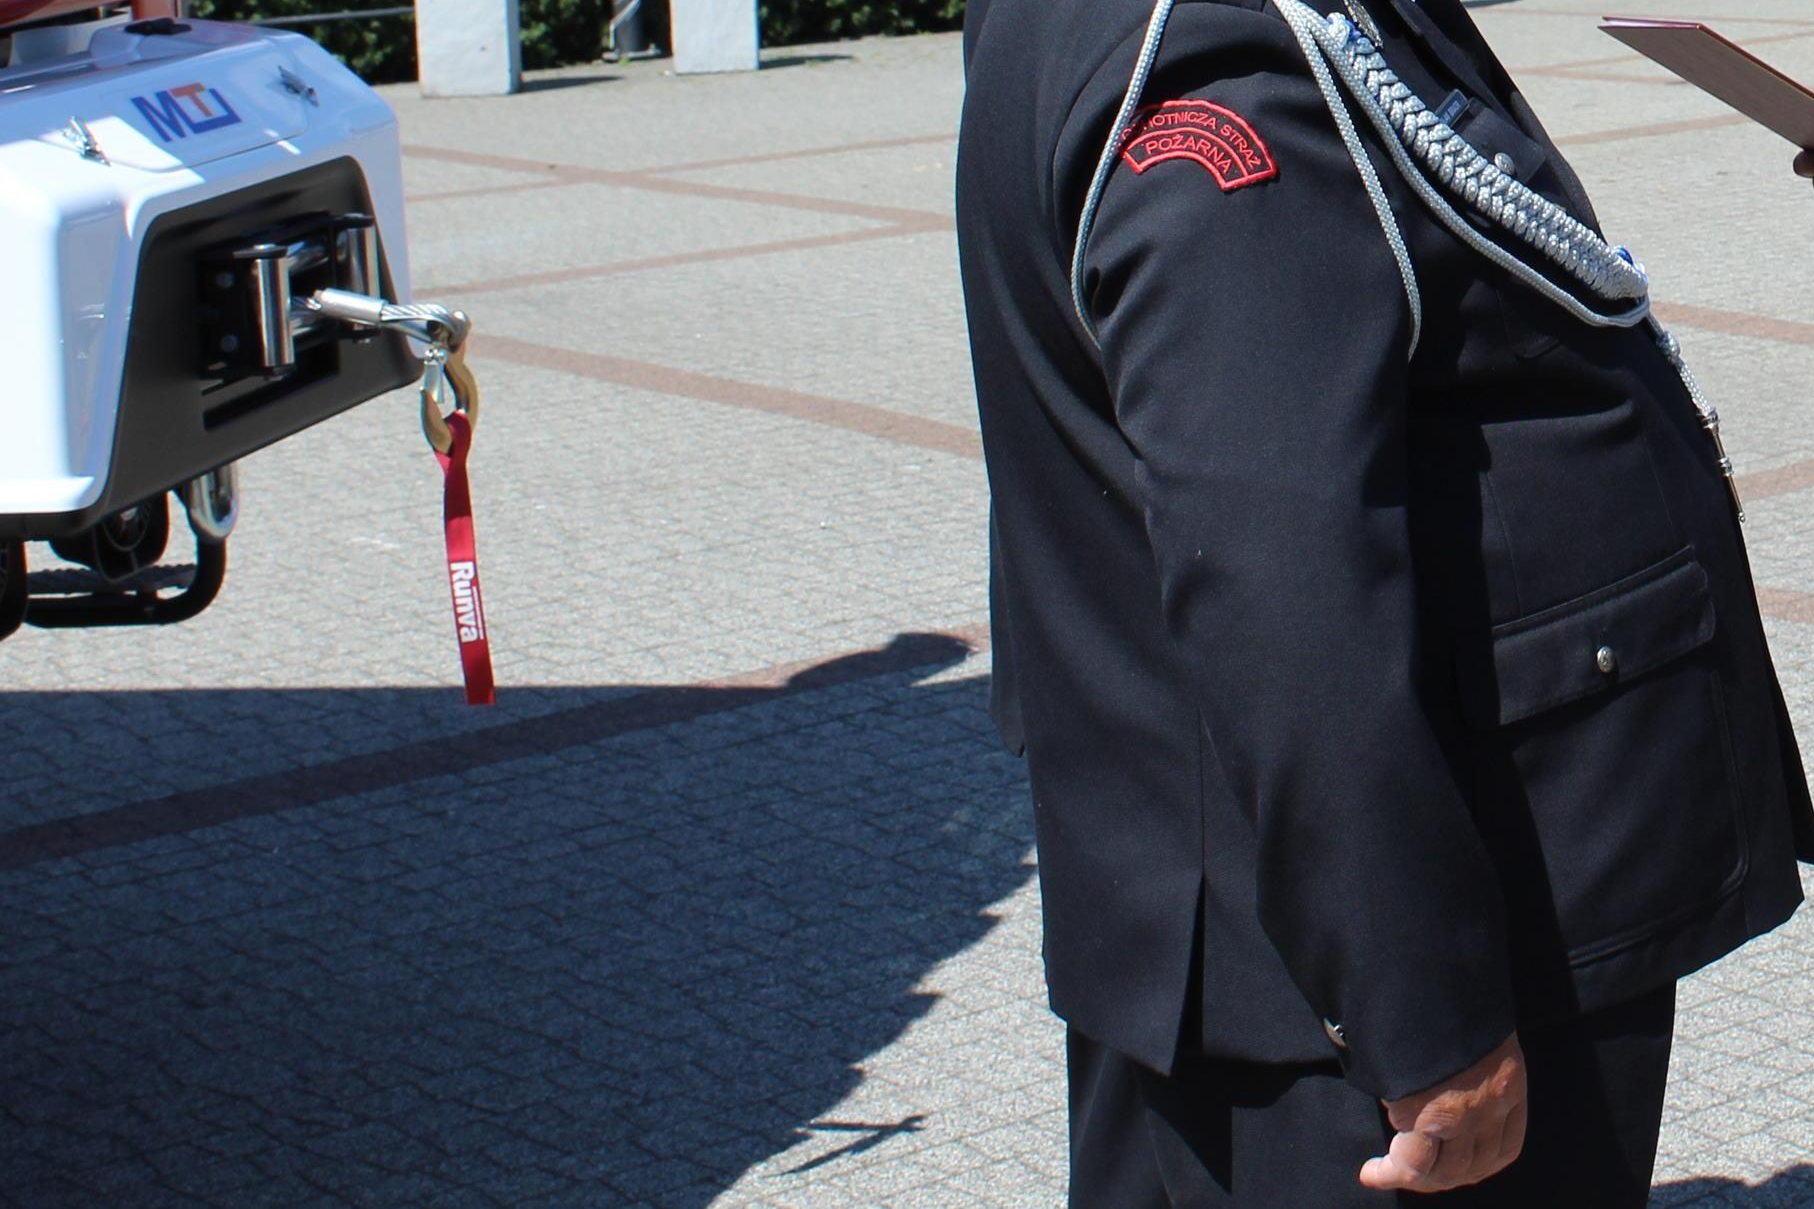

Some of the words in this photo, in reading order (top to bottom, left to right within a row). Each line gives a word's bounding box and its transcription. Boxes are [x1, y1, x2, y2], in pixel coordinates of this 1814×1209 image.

[1145, 133, 1232, 175] POŻARNA
[1220, 124, 1262, 169] STRAŻ
[450, 561, 479, 643] Runva
